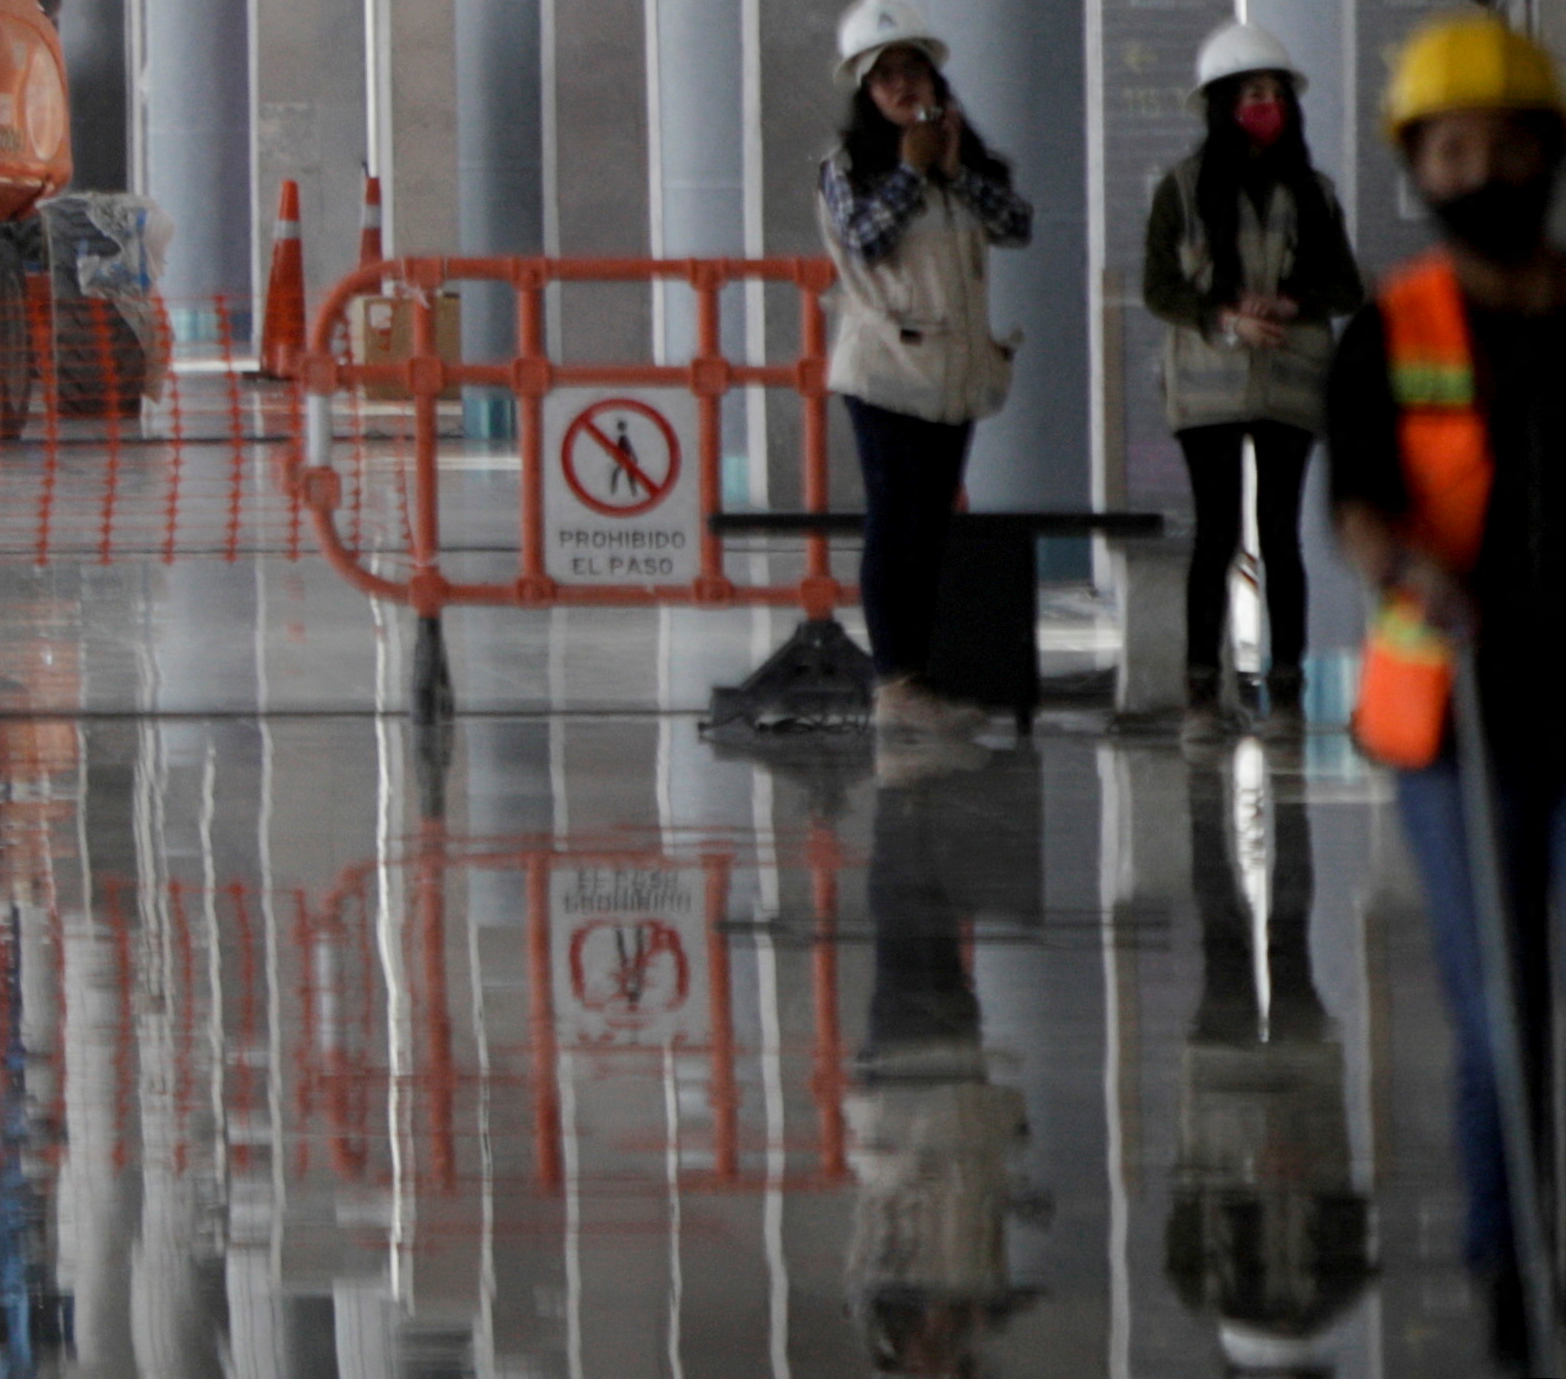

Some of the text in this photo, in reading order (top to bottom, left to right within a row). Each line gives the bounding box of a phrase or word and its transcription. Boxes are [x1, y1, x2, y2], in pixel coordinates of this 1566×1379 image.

[559, 529, 687, 550] PROHIBIDO
[572, 557, 674, 576] EL PASO
